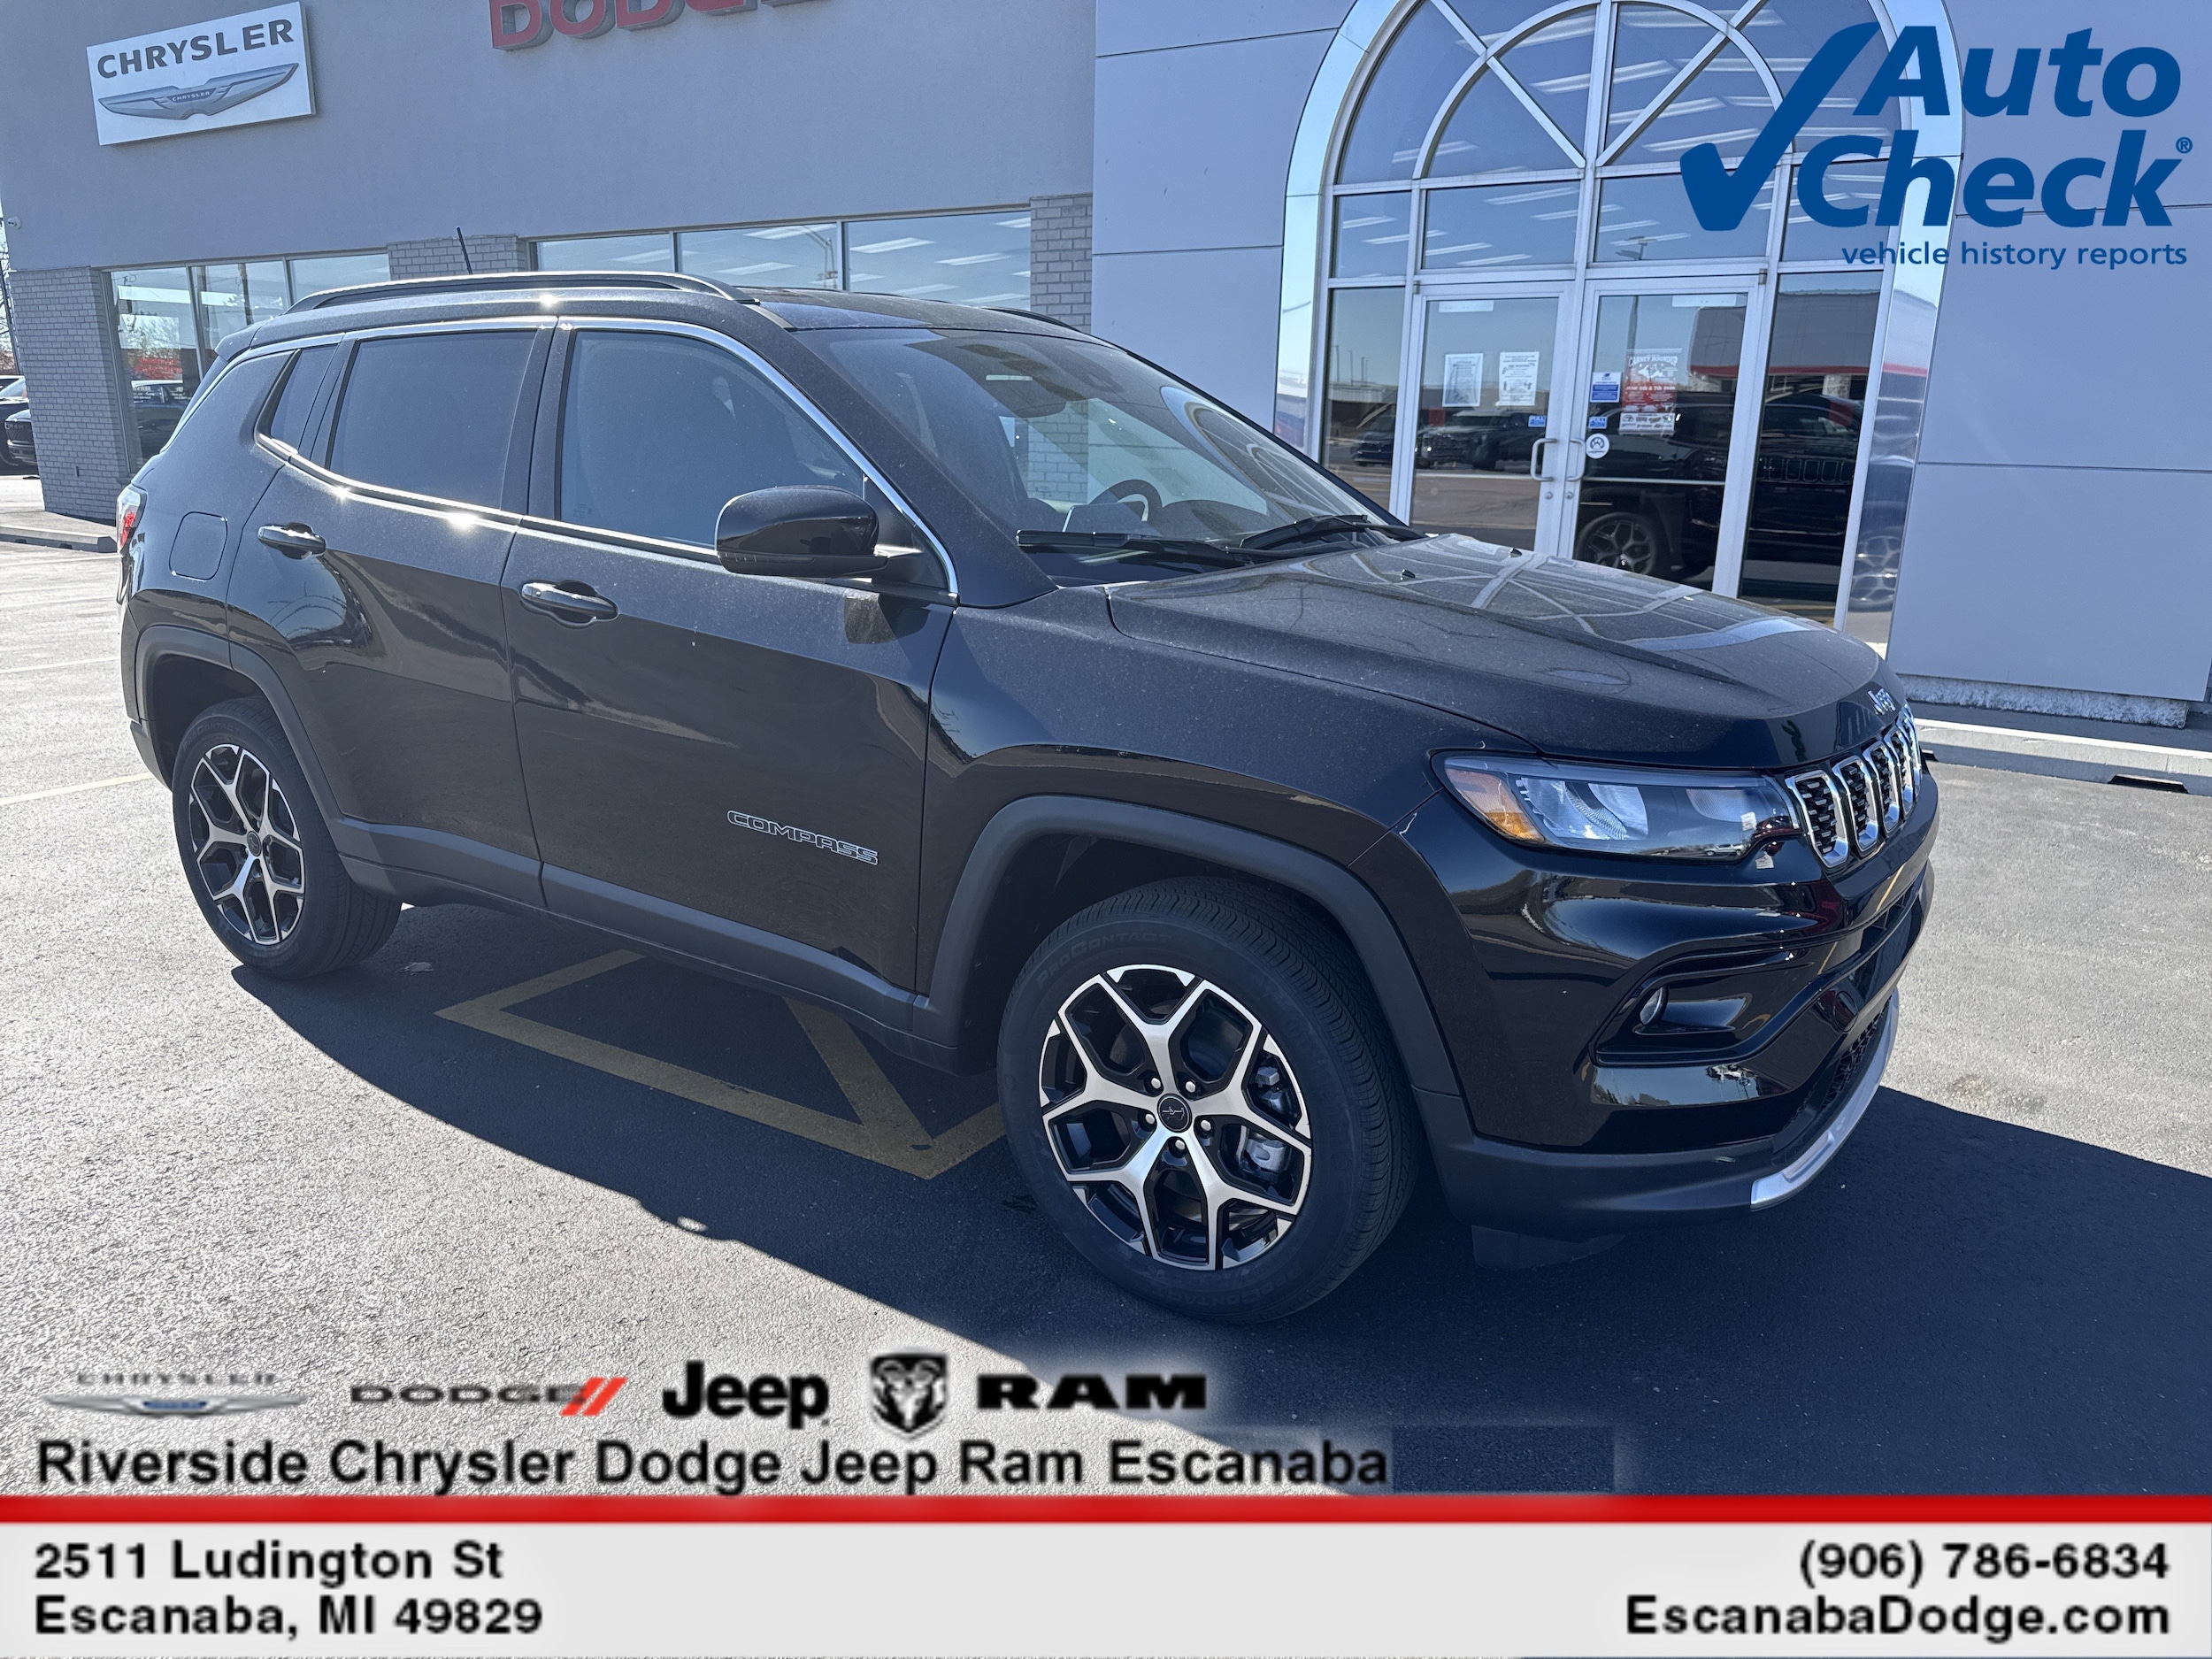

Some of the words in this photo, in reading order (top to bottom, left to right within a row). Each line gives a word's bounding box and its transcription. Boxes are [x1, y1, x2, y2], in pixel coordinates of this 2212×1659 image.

[97, 19, 294, 79] CHRYSLER
[172, 90, 210, 102] CHRYSLER
[727, 810, 878, 865] COMPASS
